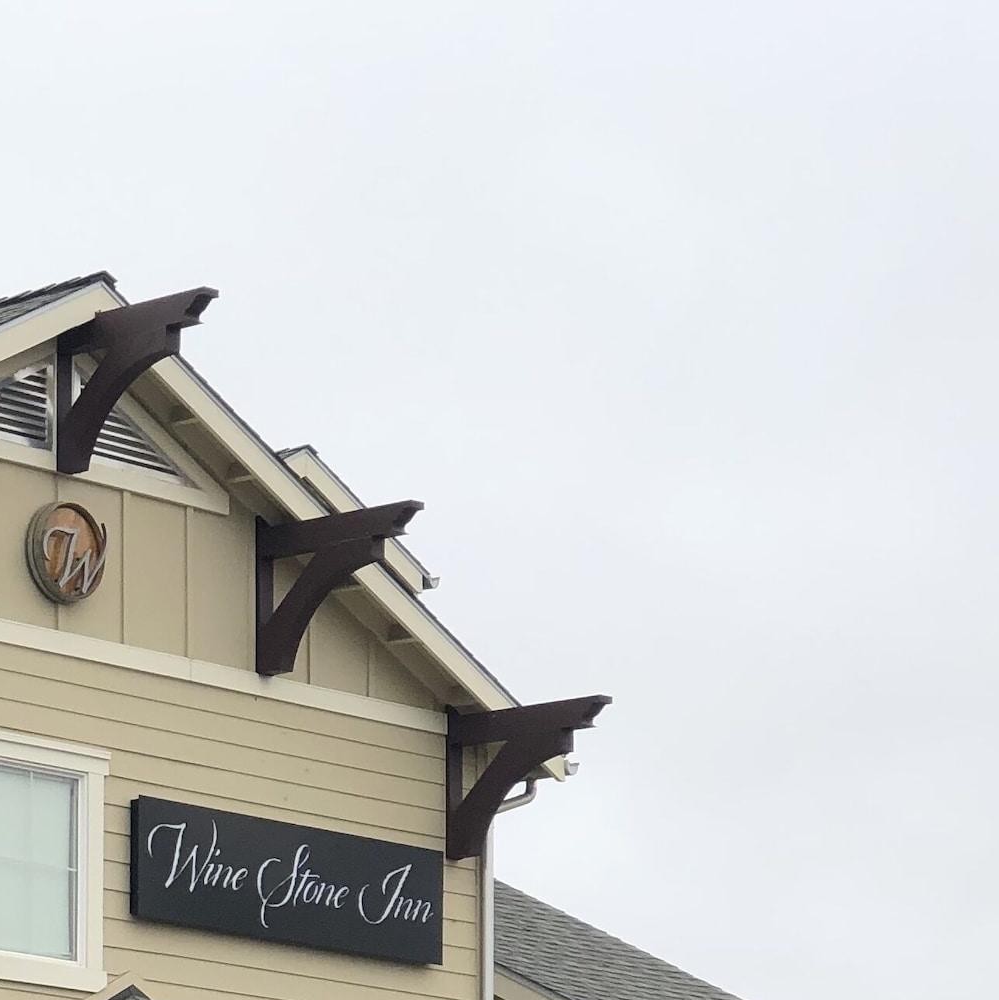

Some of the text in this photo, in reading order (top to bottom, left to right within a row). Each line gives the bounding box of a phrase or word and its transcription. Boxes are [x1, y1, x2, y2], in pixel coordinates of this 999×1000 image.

[147, 819, 434, 929] Wine Stone Inn
